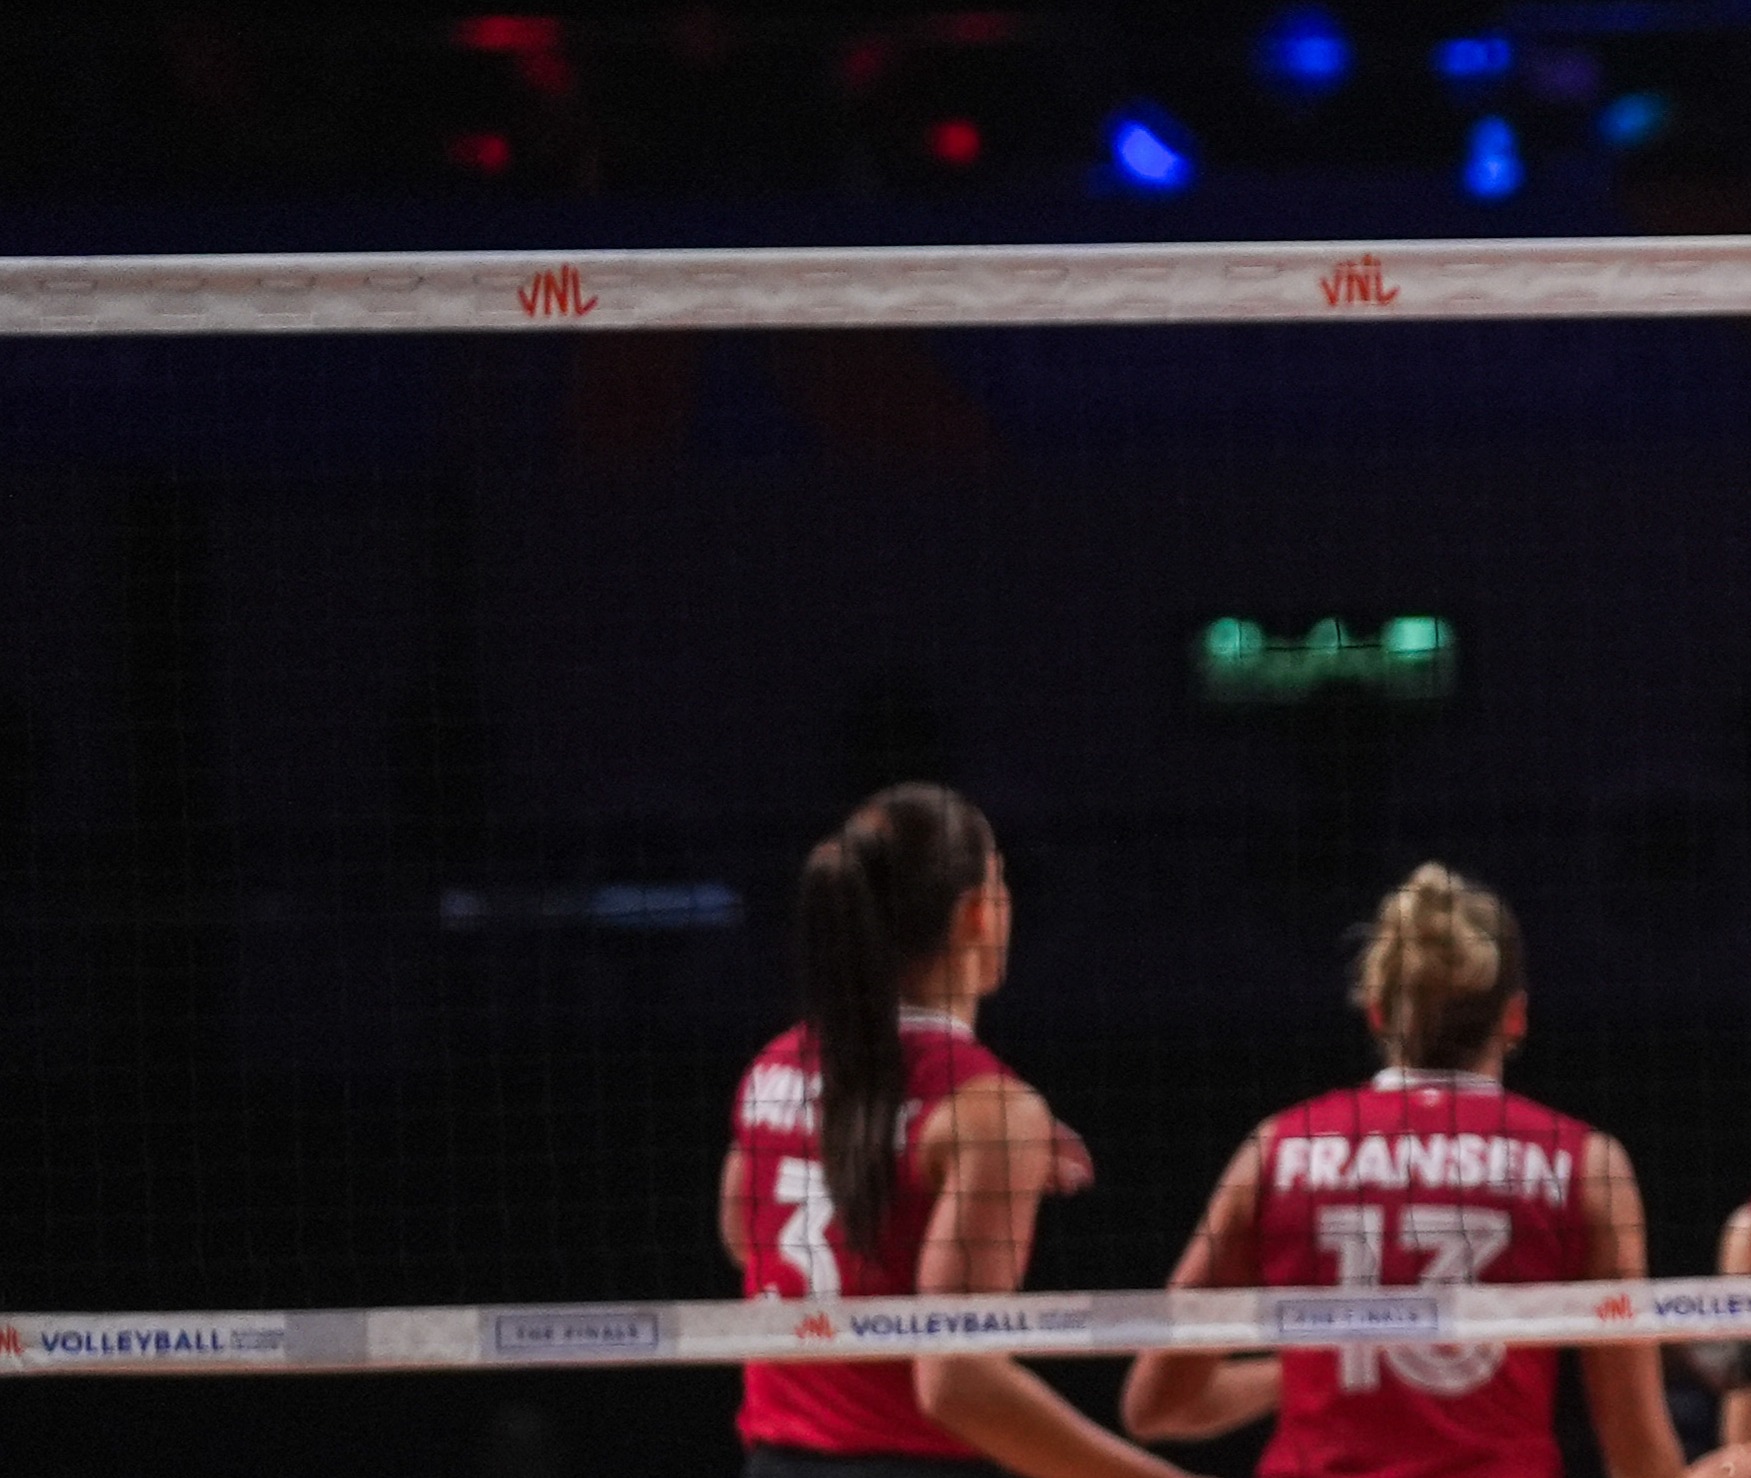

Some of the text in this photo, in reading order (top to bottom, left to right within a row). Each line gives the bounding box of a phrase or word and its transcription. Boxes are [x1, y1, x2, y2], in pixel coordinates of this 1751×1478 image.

[518, 265, 598, 318] VNL
[1320, 255, 1398, 307] VNL
[1274, 1133, 1572, 1207] FRANSEN
[41, 1328, 222, 1354] VOLLEYBALL
[850, 1311, 1030, 1336] VOLLEYBALL
